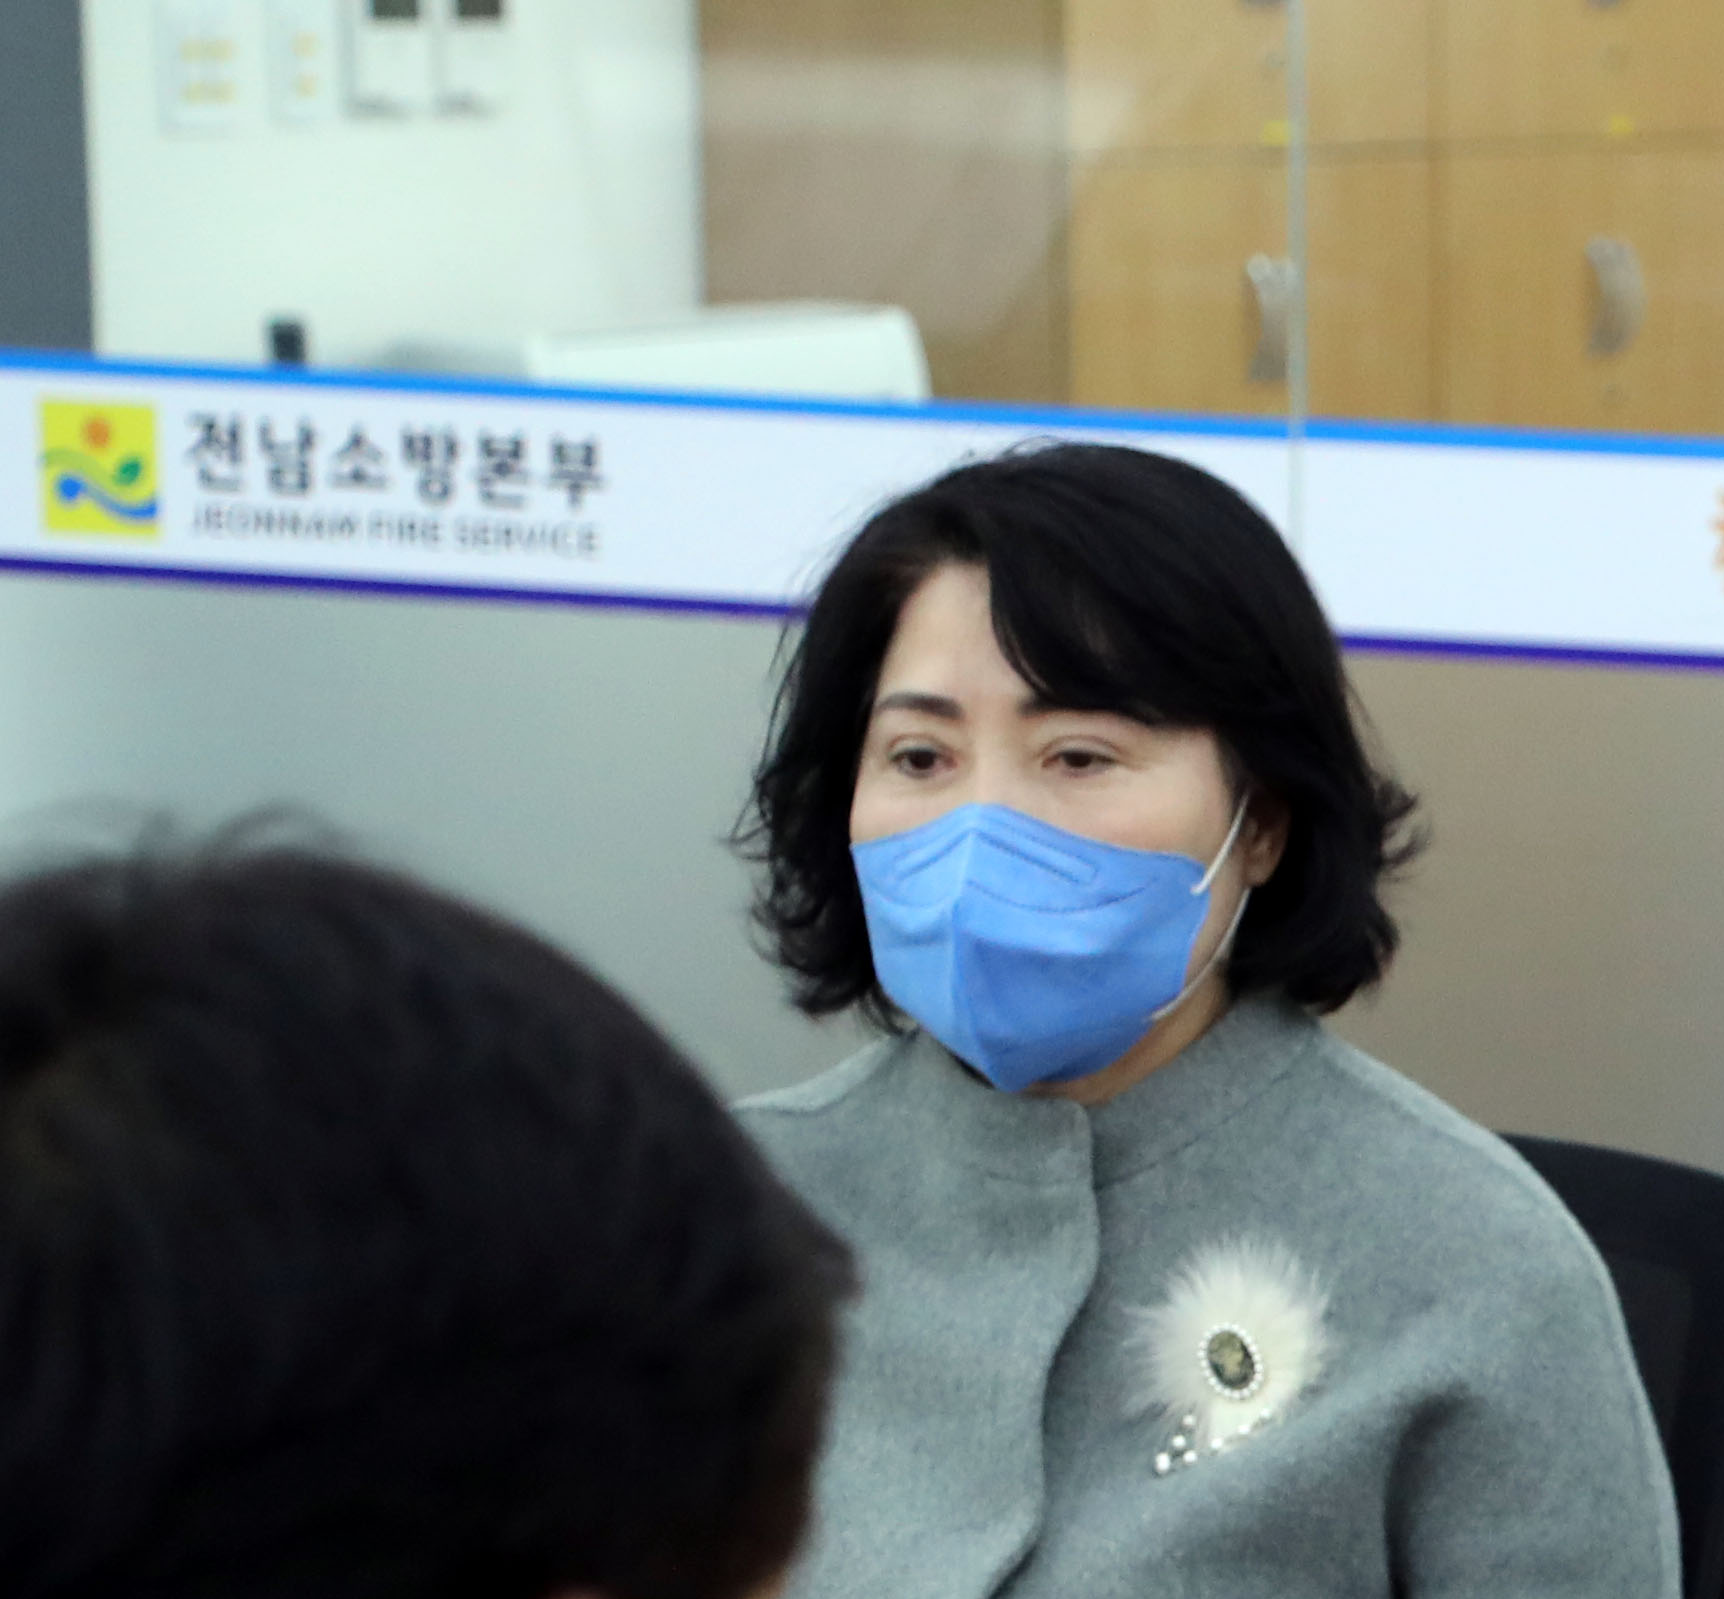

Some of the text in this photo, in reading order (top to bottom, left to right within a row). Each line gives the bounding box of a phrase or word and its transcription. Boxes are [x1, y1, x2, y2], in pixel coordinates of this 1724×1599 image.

[188, 412, 604, 510] 전남소방본부
[194, 503, 601, 558] JEONNAM FIRE SERVICE
